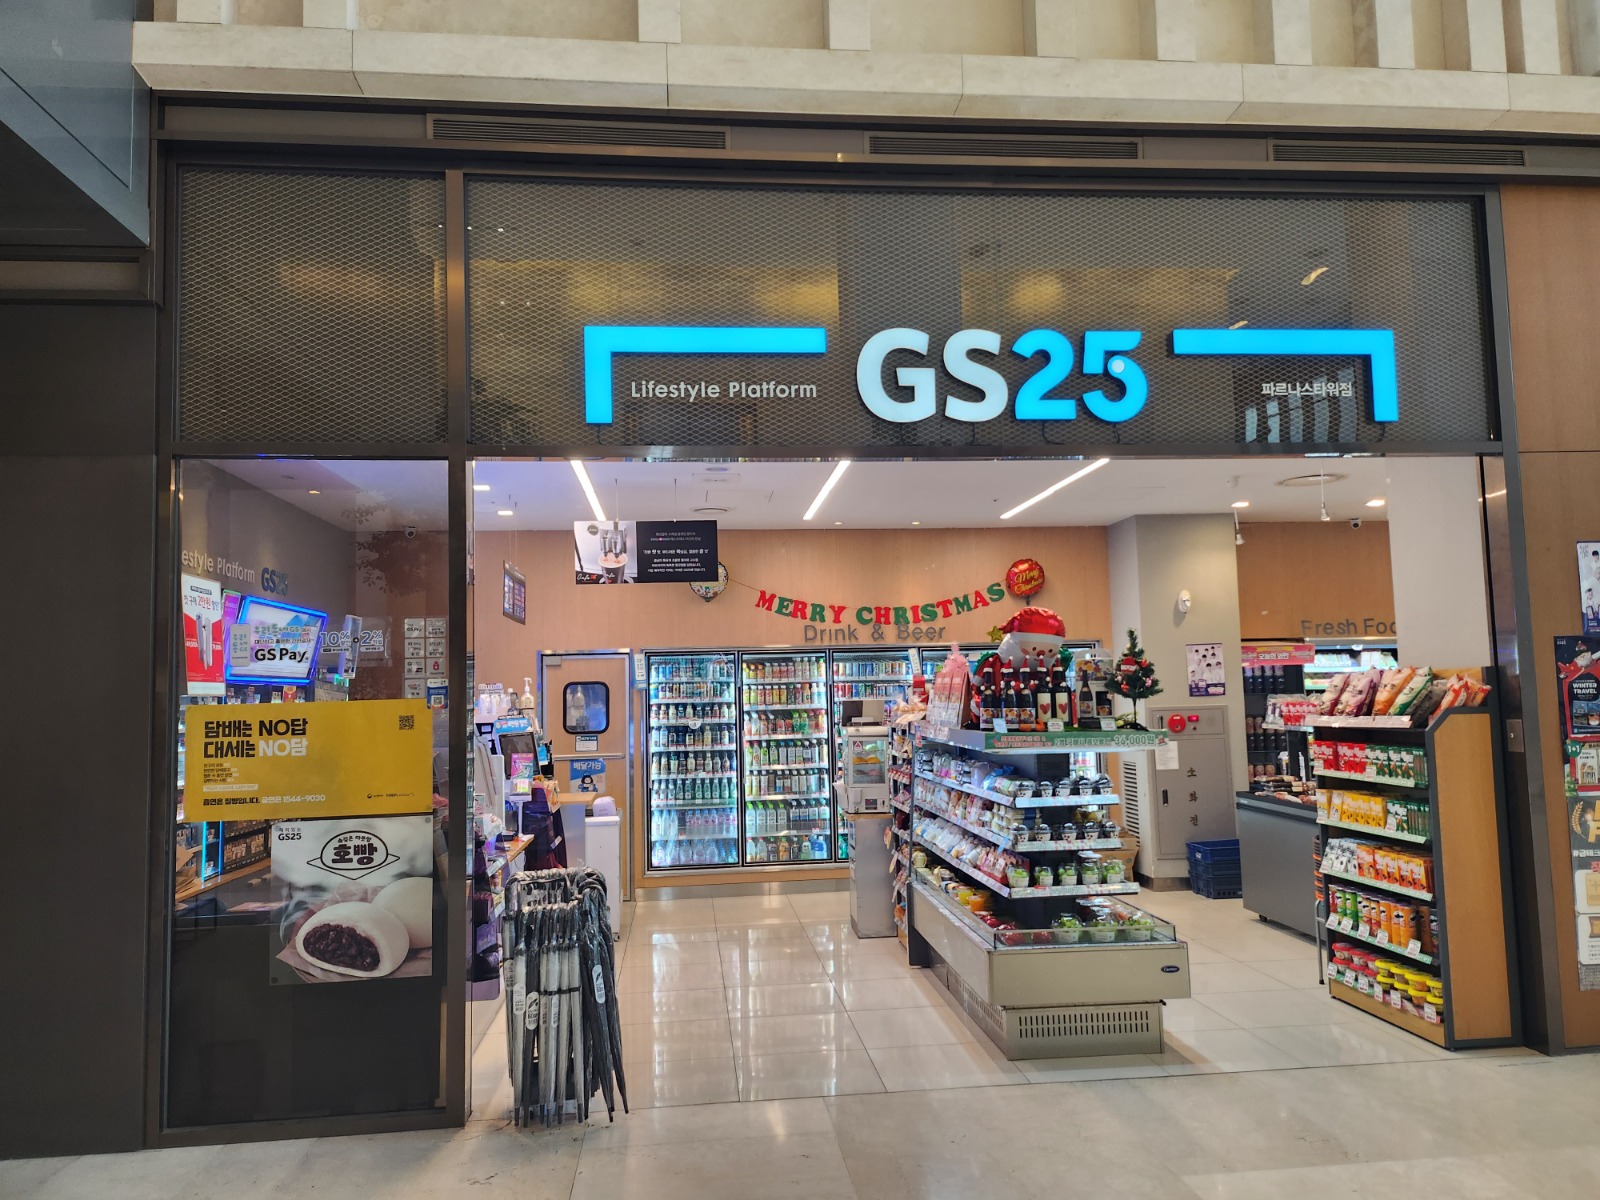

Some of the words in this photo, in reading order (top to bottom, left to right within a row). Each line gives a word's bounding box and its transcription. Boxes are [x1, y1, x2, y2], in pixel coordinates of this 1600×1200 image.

[856, 327, 1148, 422] GS25
[631, 381, 720, 402] Lifestyle
[729, 381, 817, 398] Platform
[1261, 382, 1352, 397] 파르나스타워점
[217, 557, 255, 583] Platform
[261, 567, 288, 596] GS25
[755, 590, 847, 623] MERRY
[856, 582, 1005, 625] CHRISTMAS
[804, 624, 858, 643] Drink
[871, 624, 885, 640] &
[897, 624, 946, 642] Beer
[1301, 618, 1357, 635] Fresh
[254, 648, 276, 661] GS
[204, 720, 252, 738] 담배는
[259, 718, 308, 736] NO답
[203, 740, 255, 758] 대세는
[259, 738, 308, 756] NO담
[278, 833, 302, 841] GS25
[332, 843, 377, 865] 호빵
